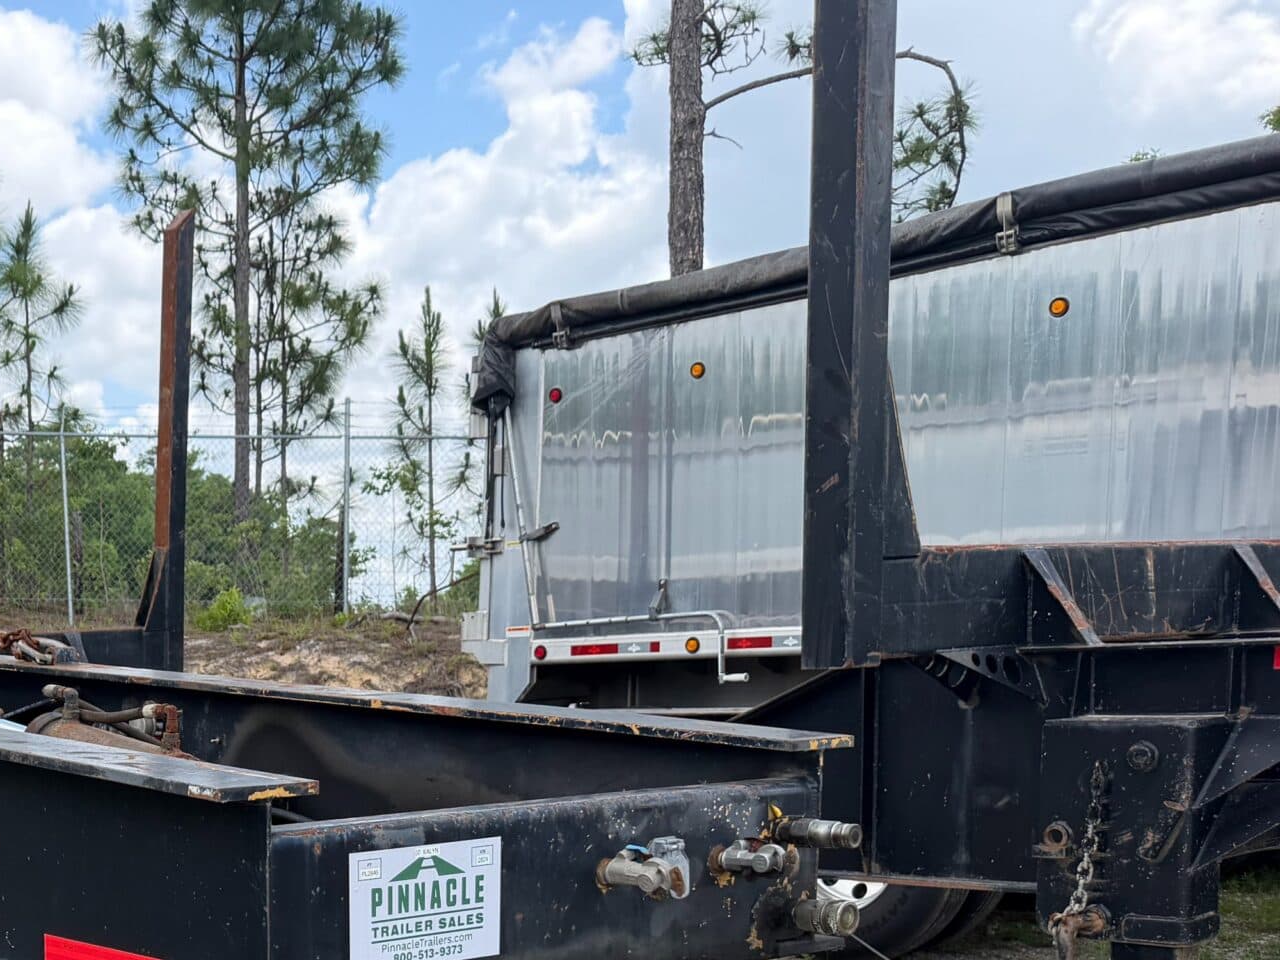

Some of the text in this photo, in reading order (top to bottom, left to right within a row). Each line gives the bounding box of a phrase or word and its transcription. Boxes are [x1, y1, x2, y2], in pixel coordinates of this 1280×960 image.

[371, 874, 485, 918] PINNACLE
[371, 912, 484, 939] TRAILER SALES
[381, 933, 473, 954] PinnacleTrailers.com
